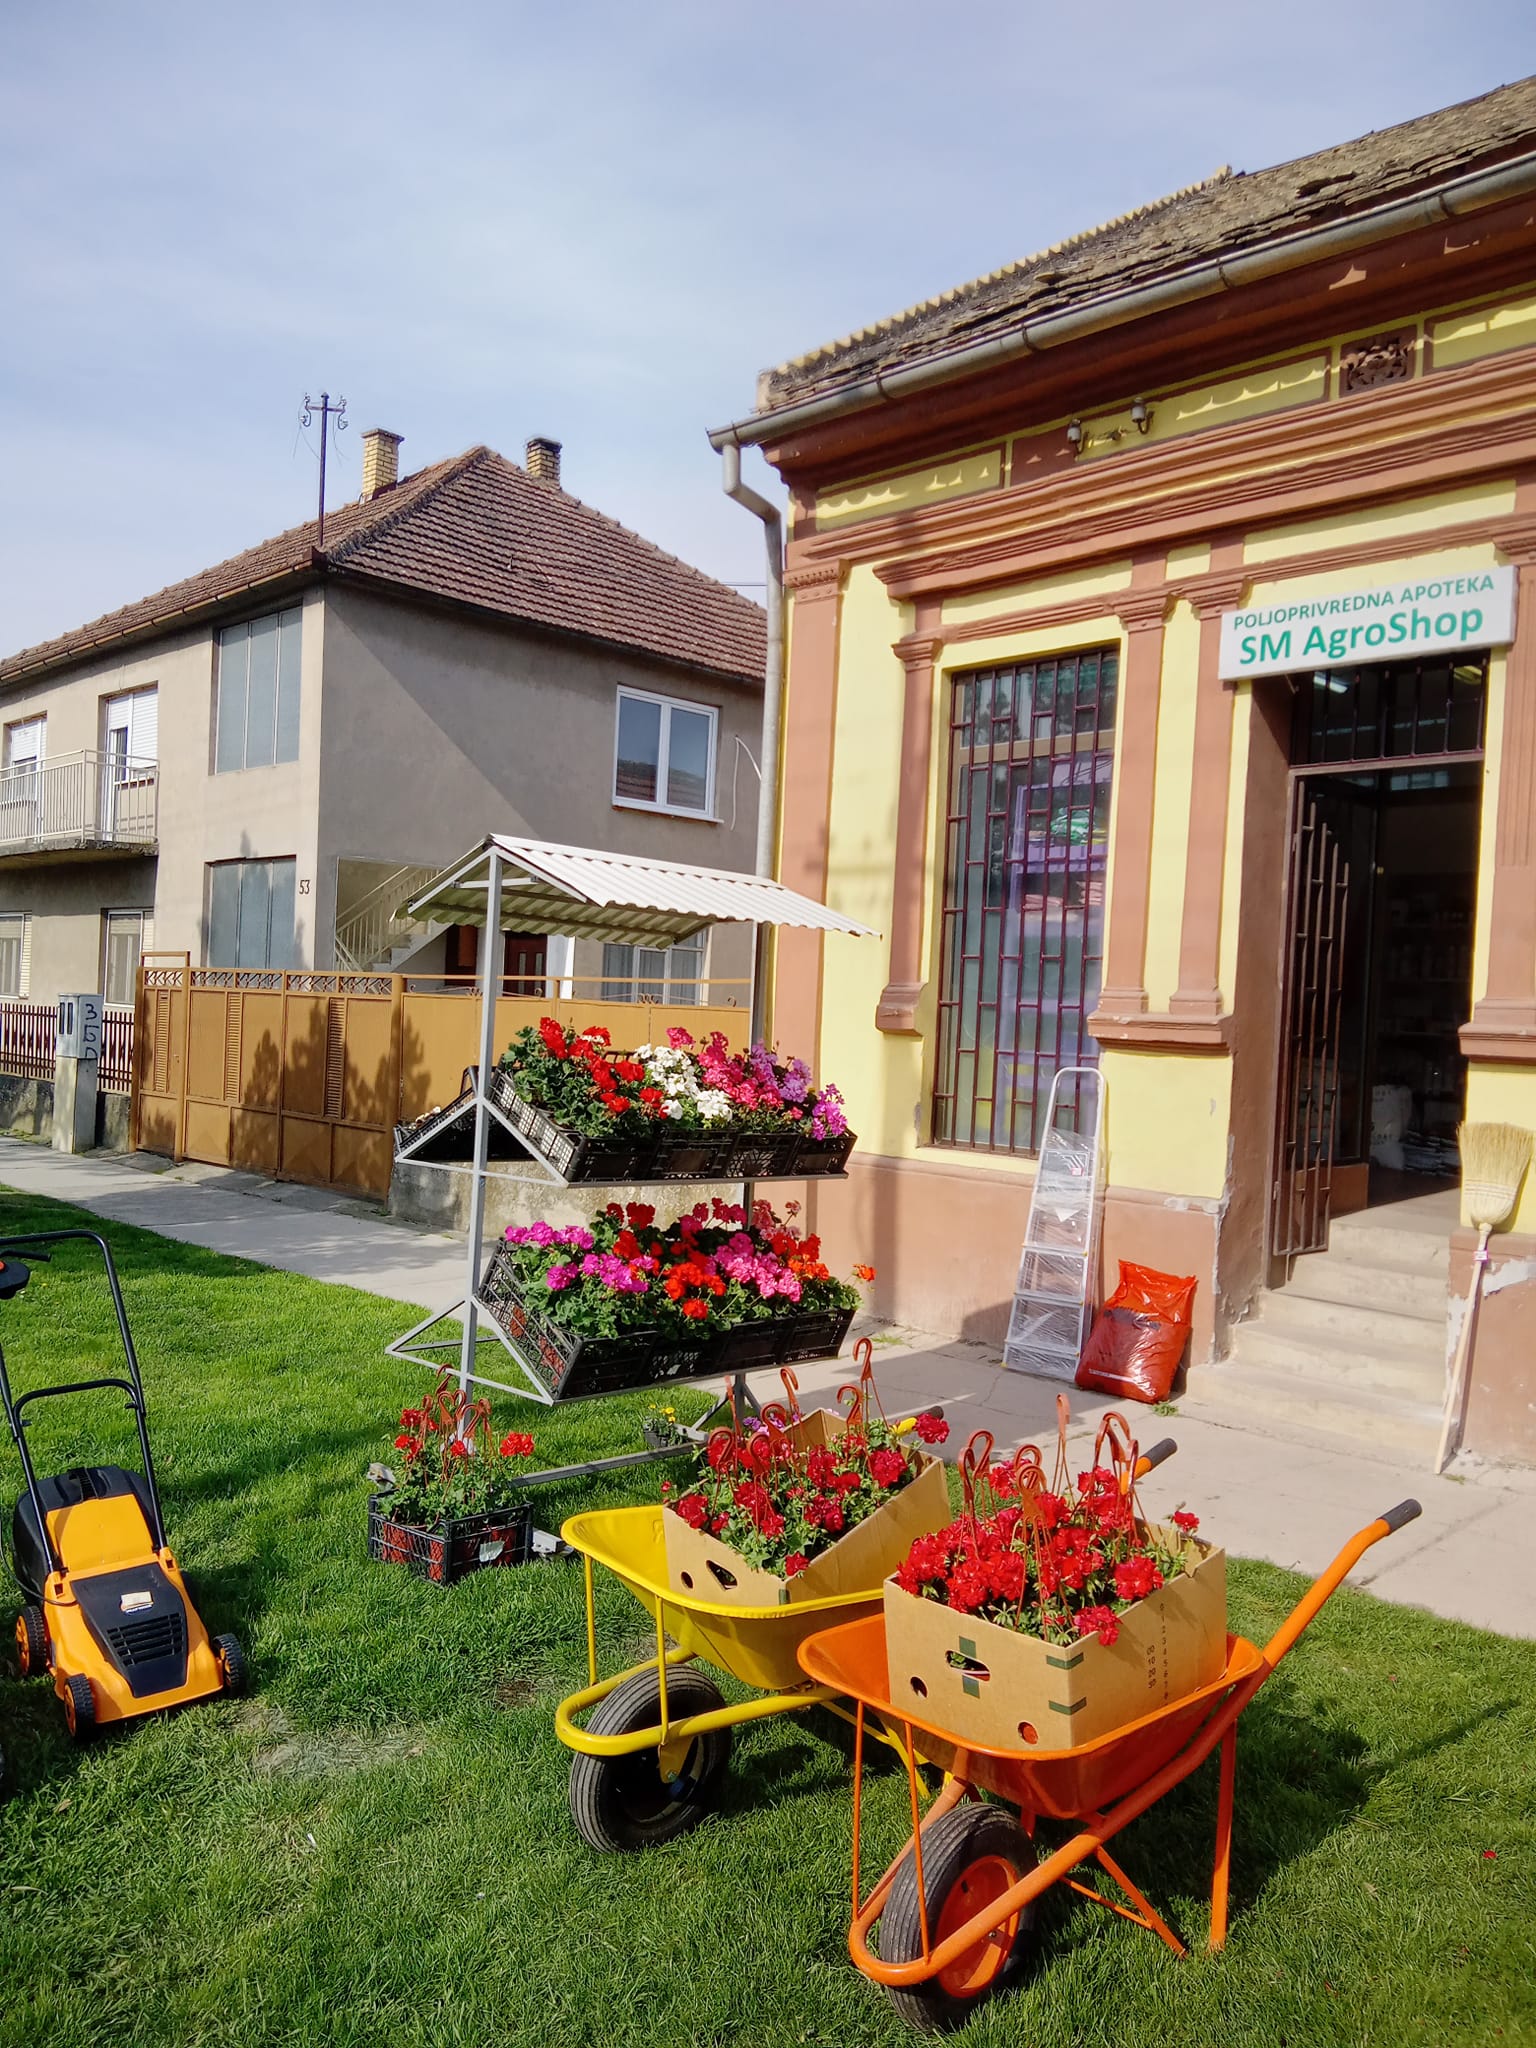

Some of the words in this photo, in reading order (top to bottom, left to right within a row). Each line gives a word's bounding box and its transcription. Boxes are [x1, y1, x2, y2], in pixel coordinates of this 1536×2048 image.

[1234, 591, 1395, 630] POLJOPRIVREDNA
[1400, 575, 1494, 603] APOTEKA
[1239, 630, 1292, 666] SM
[1302, 607, 1484, 660] AgroShop
[299, 879, 310, 895] 53
